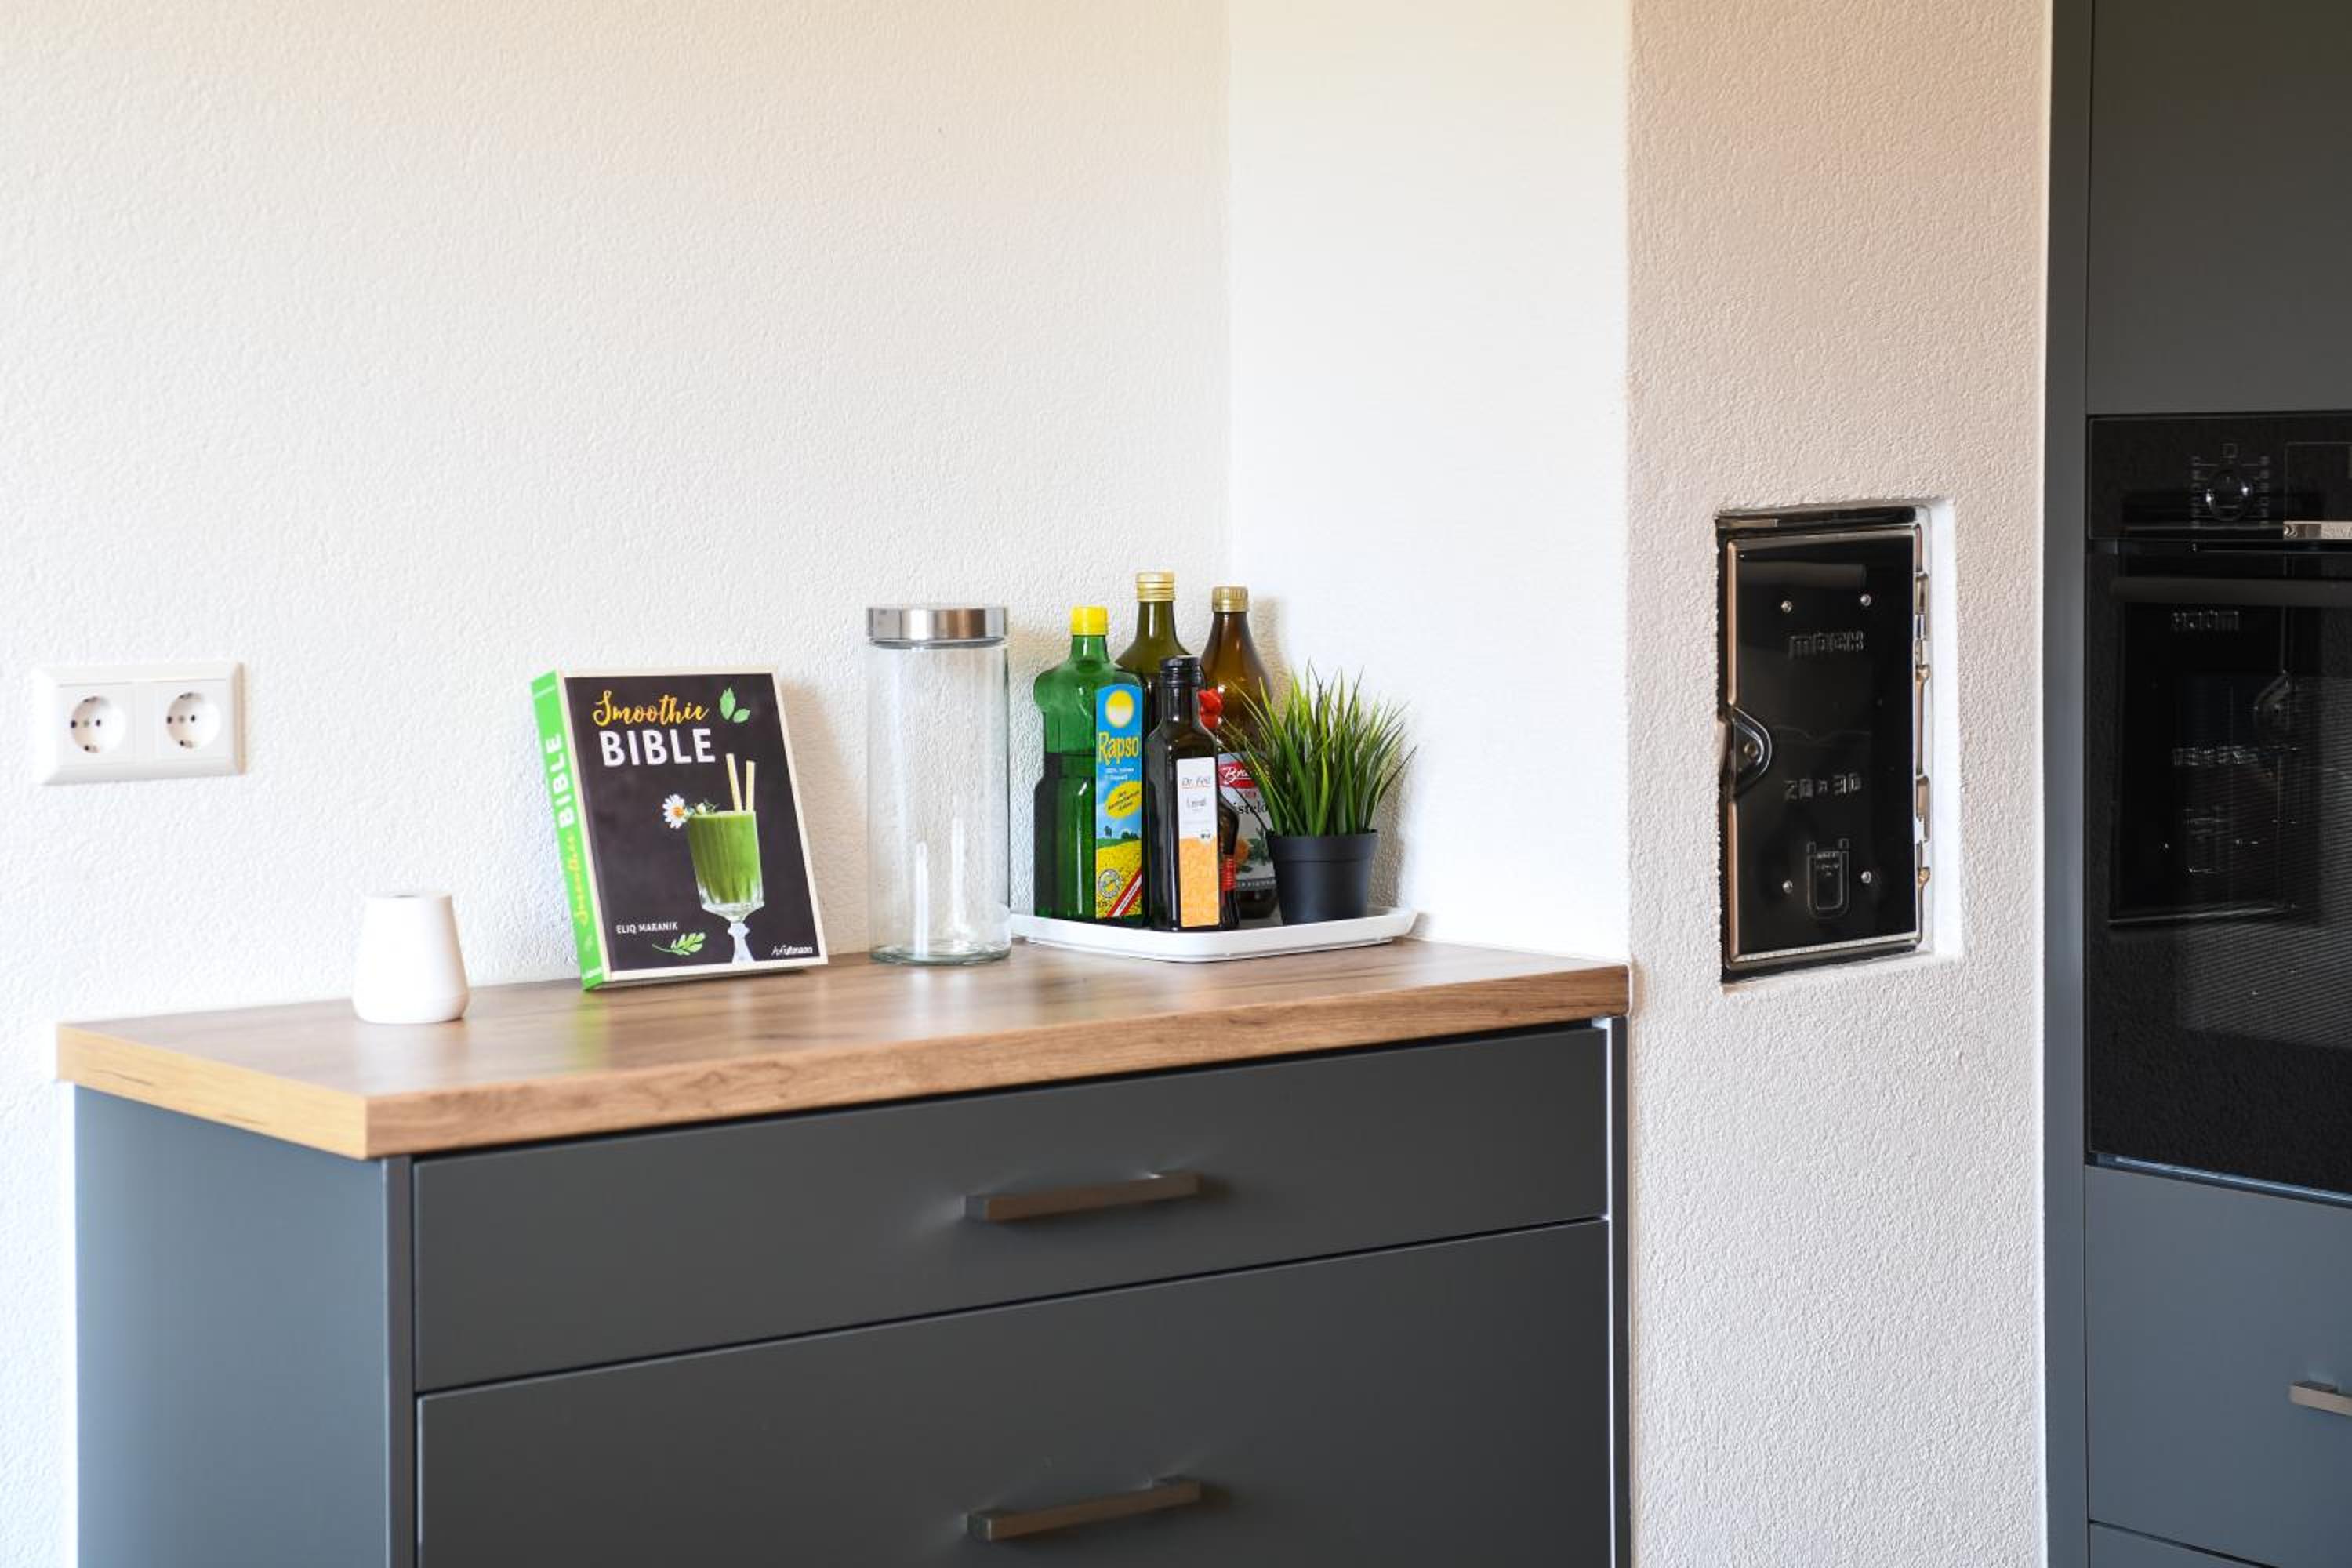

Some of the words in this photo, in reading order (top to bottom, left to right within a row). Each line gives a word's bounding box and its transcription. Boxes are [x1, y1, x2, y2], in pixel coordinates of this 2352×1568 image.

[593, 689, 710, 727] Smoothie
[599, 728, 716, 767] BIBLE
[1098, 731, 1140, 766] Rapso
[546, 734, 575, 828] BIBLE
[615, 924, 637, 934] ELIQ
[639, 921, 678, 932] MARANIK
